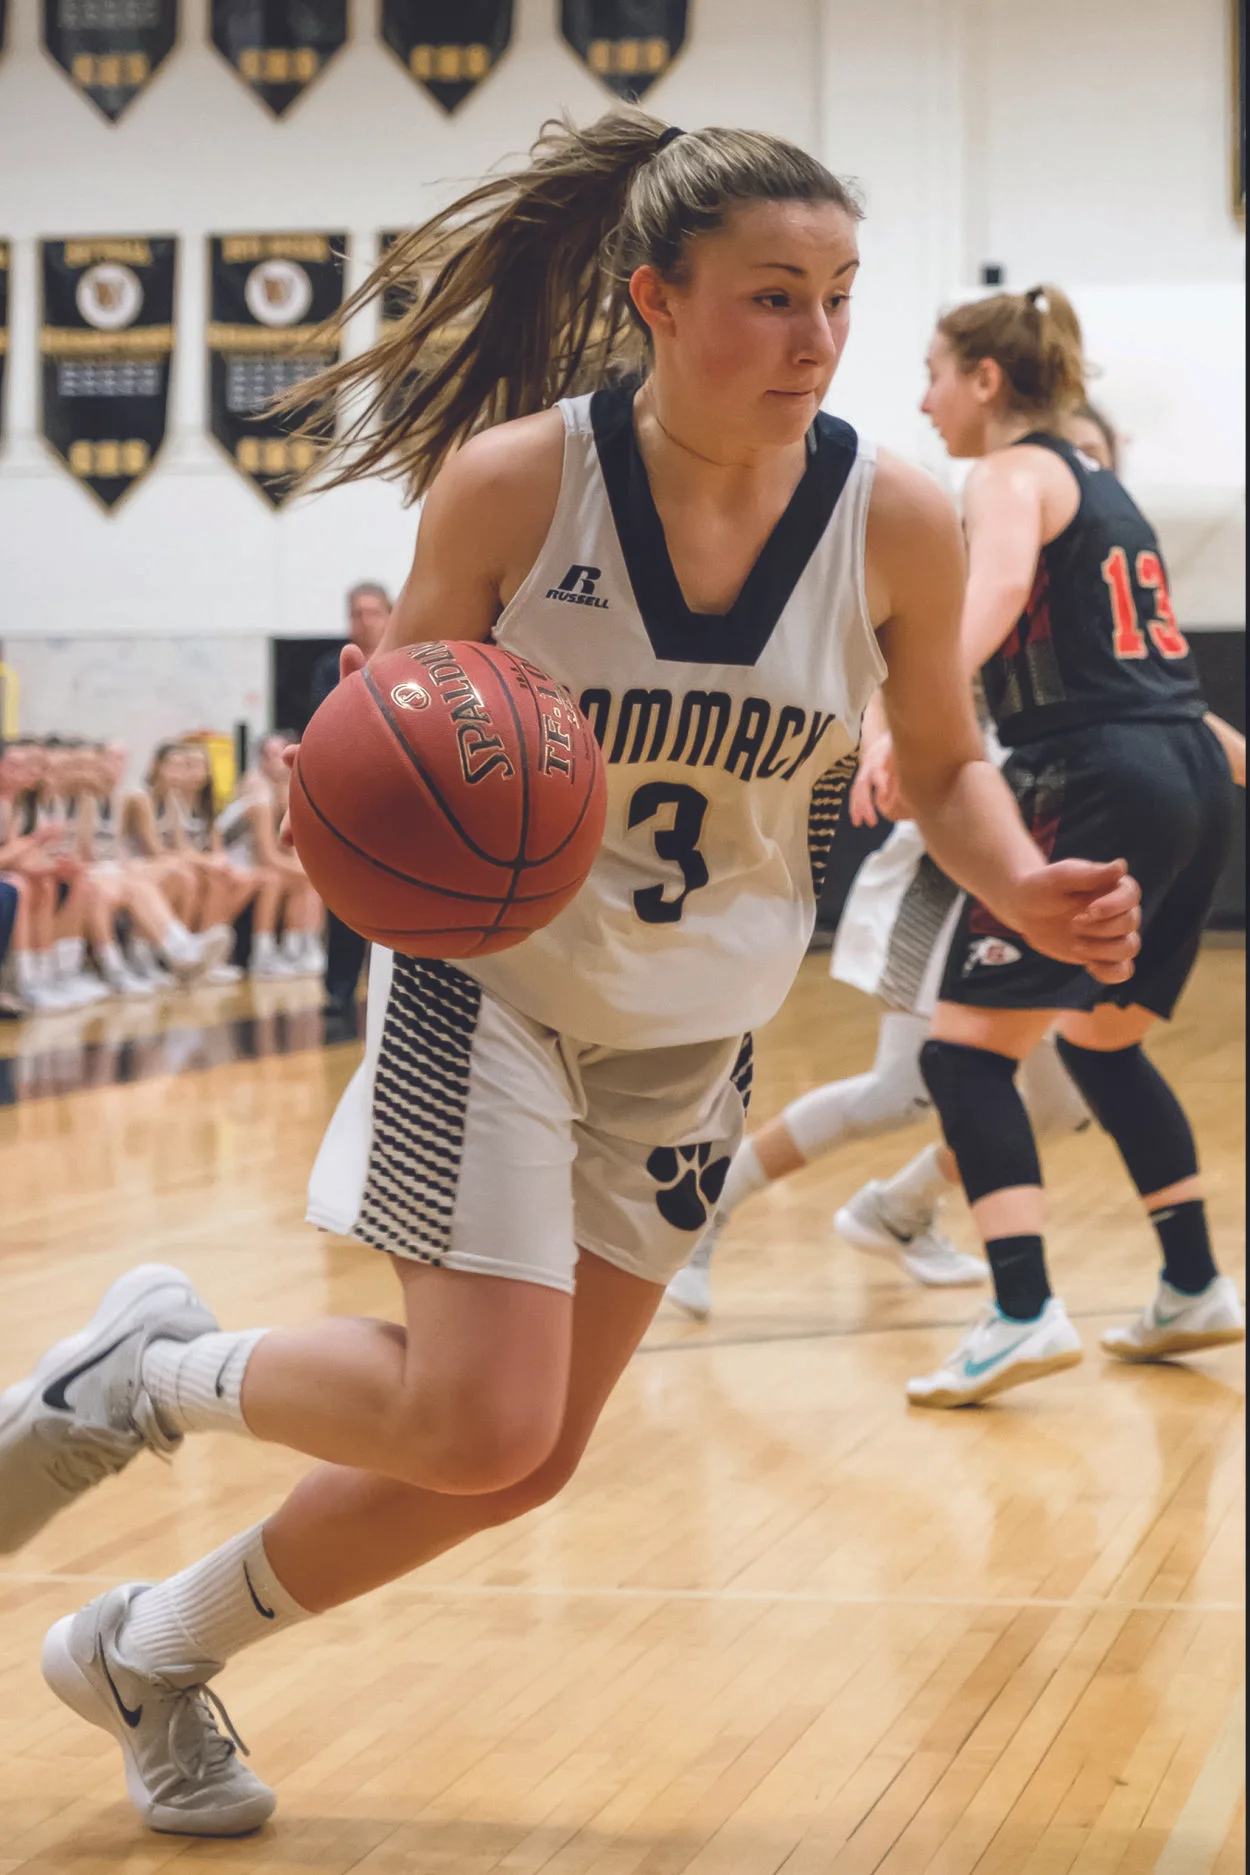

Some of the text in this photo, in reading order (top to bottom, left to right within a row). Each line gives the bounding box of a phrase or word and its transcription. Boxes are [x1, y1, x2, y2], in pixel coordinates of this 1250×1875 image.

[545, 588, 610, 610] RUSSELL
[1102, 546, 1189, 660] 13
[577, 688, 836, 782] OMMACK
[627, 781, 710, 923] 3
